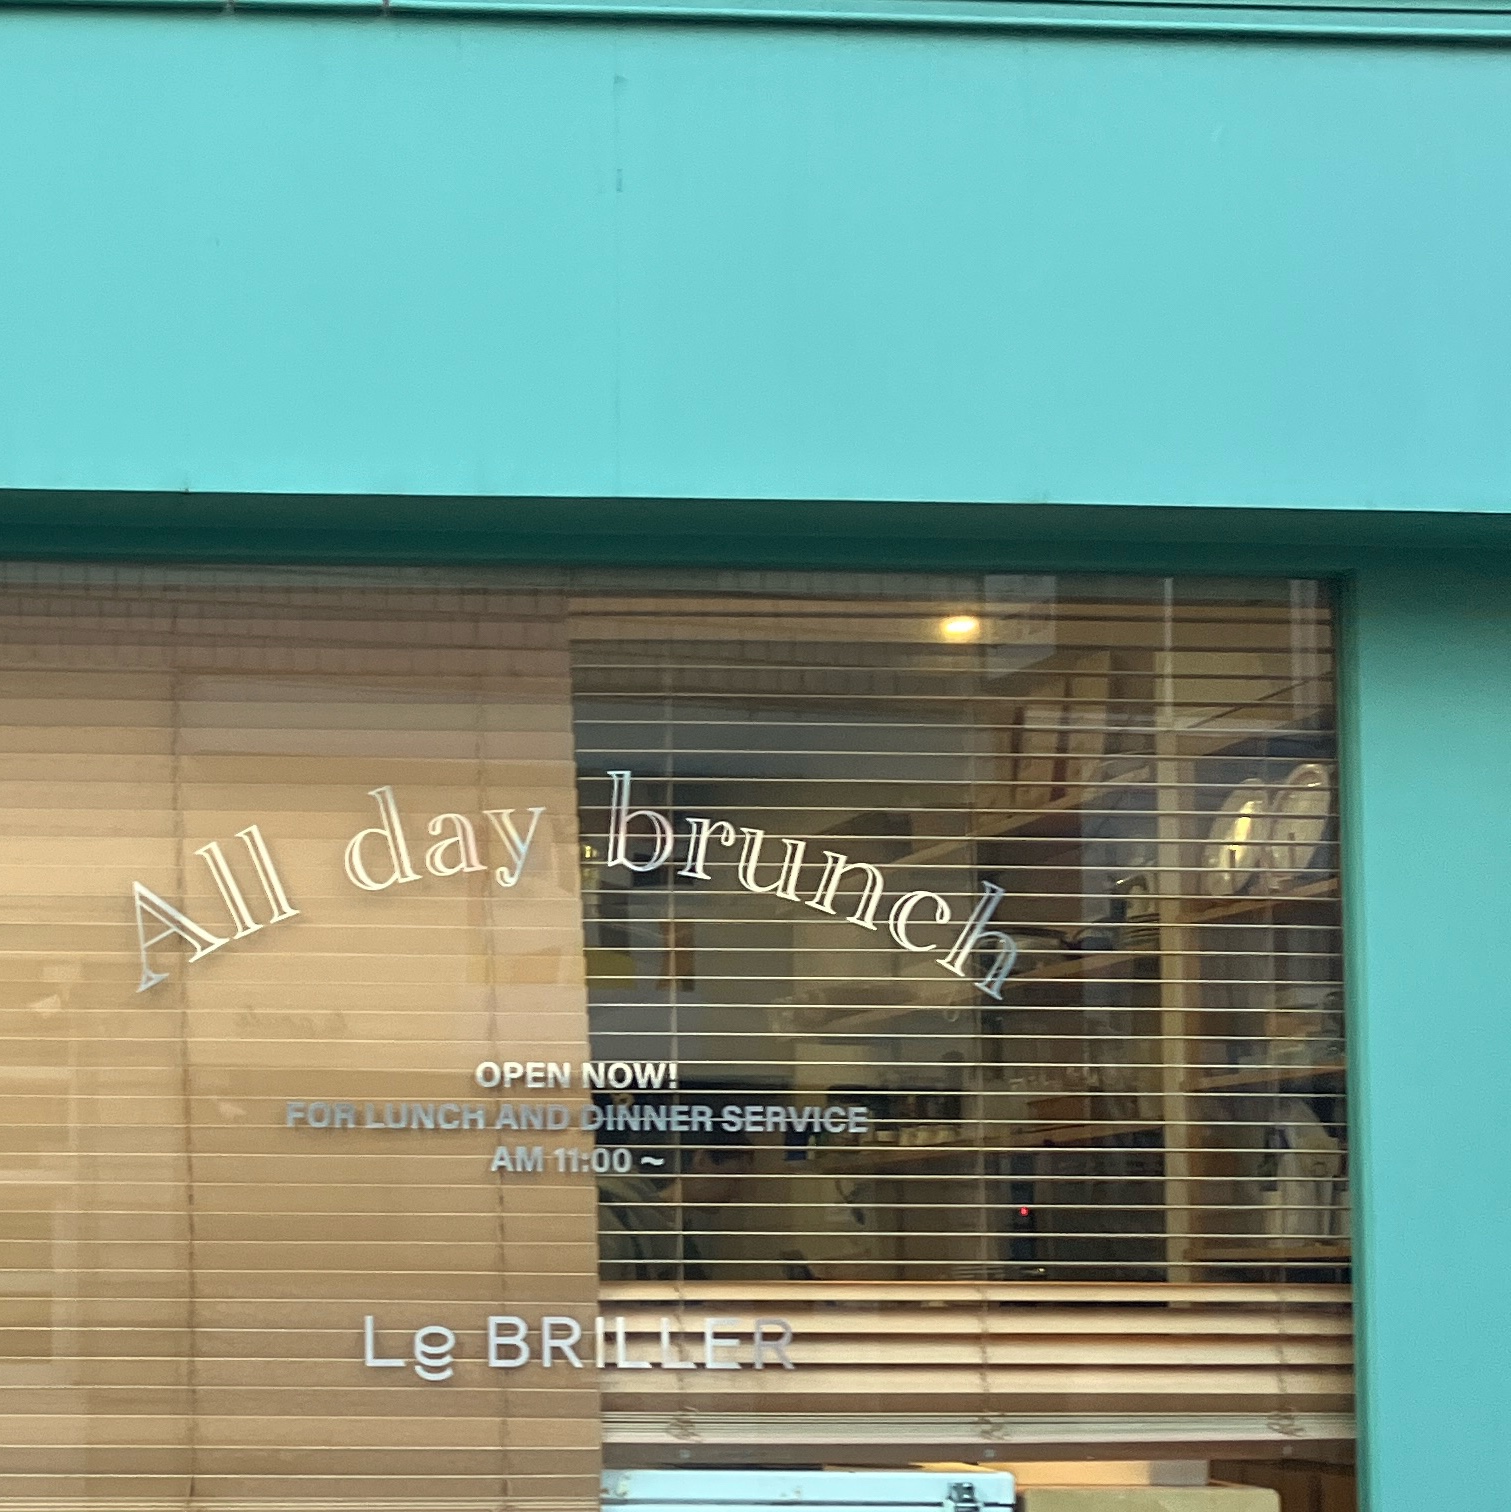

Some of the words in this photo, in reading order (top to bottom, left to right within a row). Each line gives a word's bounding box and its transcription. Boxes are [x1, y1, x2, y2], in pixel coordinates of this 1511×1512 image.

[133, 824, 300, 993] All
[344, 785, 546, 891] day
[607, 770, 1018, 1000] brunch
[475, 1061, 571, 1089] OPEN
[581, 1061, 678, 1089] NOW!
[286, 1101, 356, 1129] FOR
[364, 1102, 486, 1130] LUNCH
[495, 1103, 570, 1131] AND
[580, 1104, 714, 1132] DINNER
[721, 1105, 870, 1134] SERVICE
[490, 1145, 543, 1173] AM
[554, 1147, 633, 1174] 11:00
[364, 1314, 456, 1381] Le
[488, 1315, 796, 1370] BRILLER
